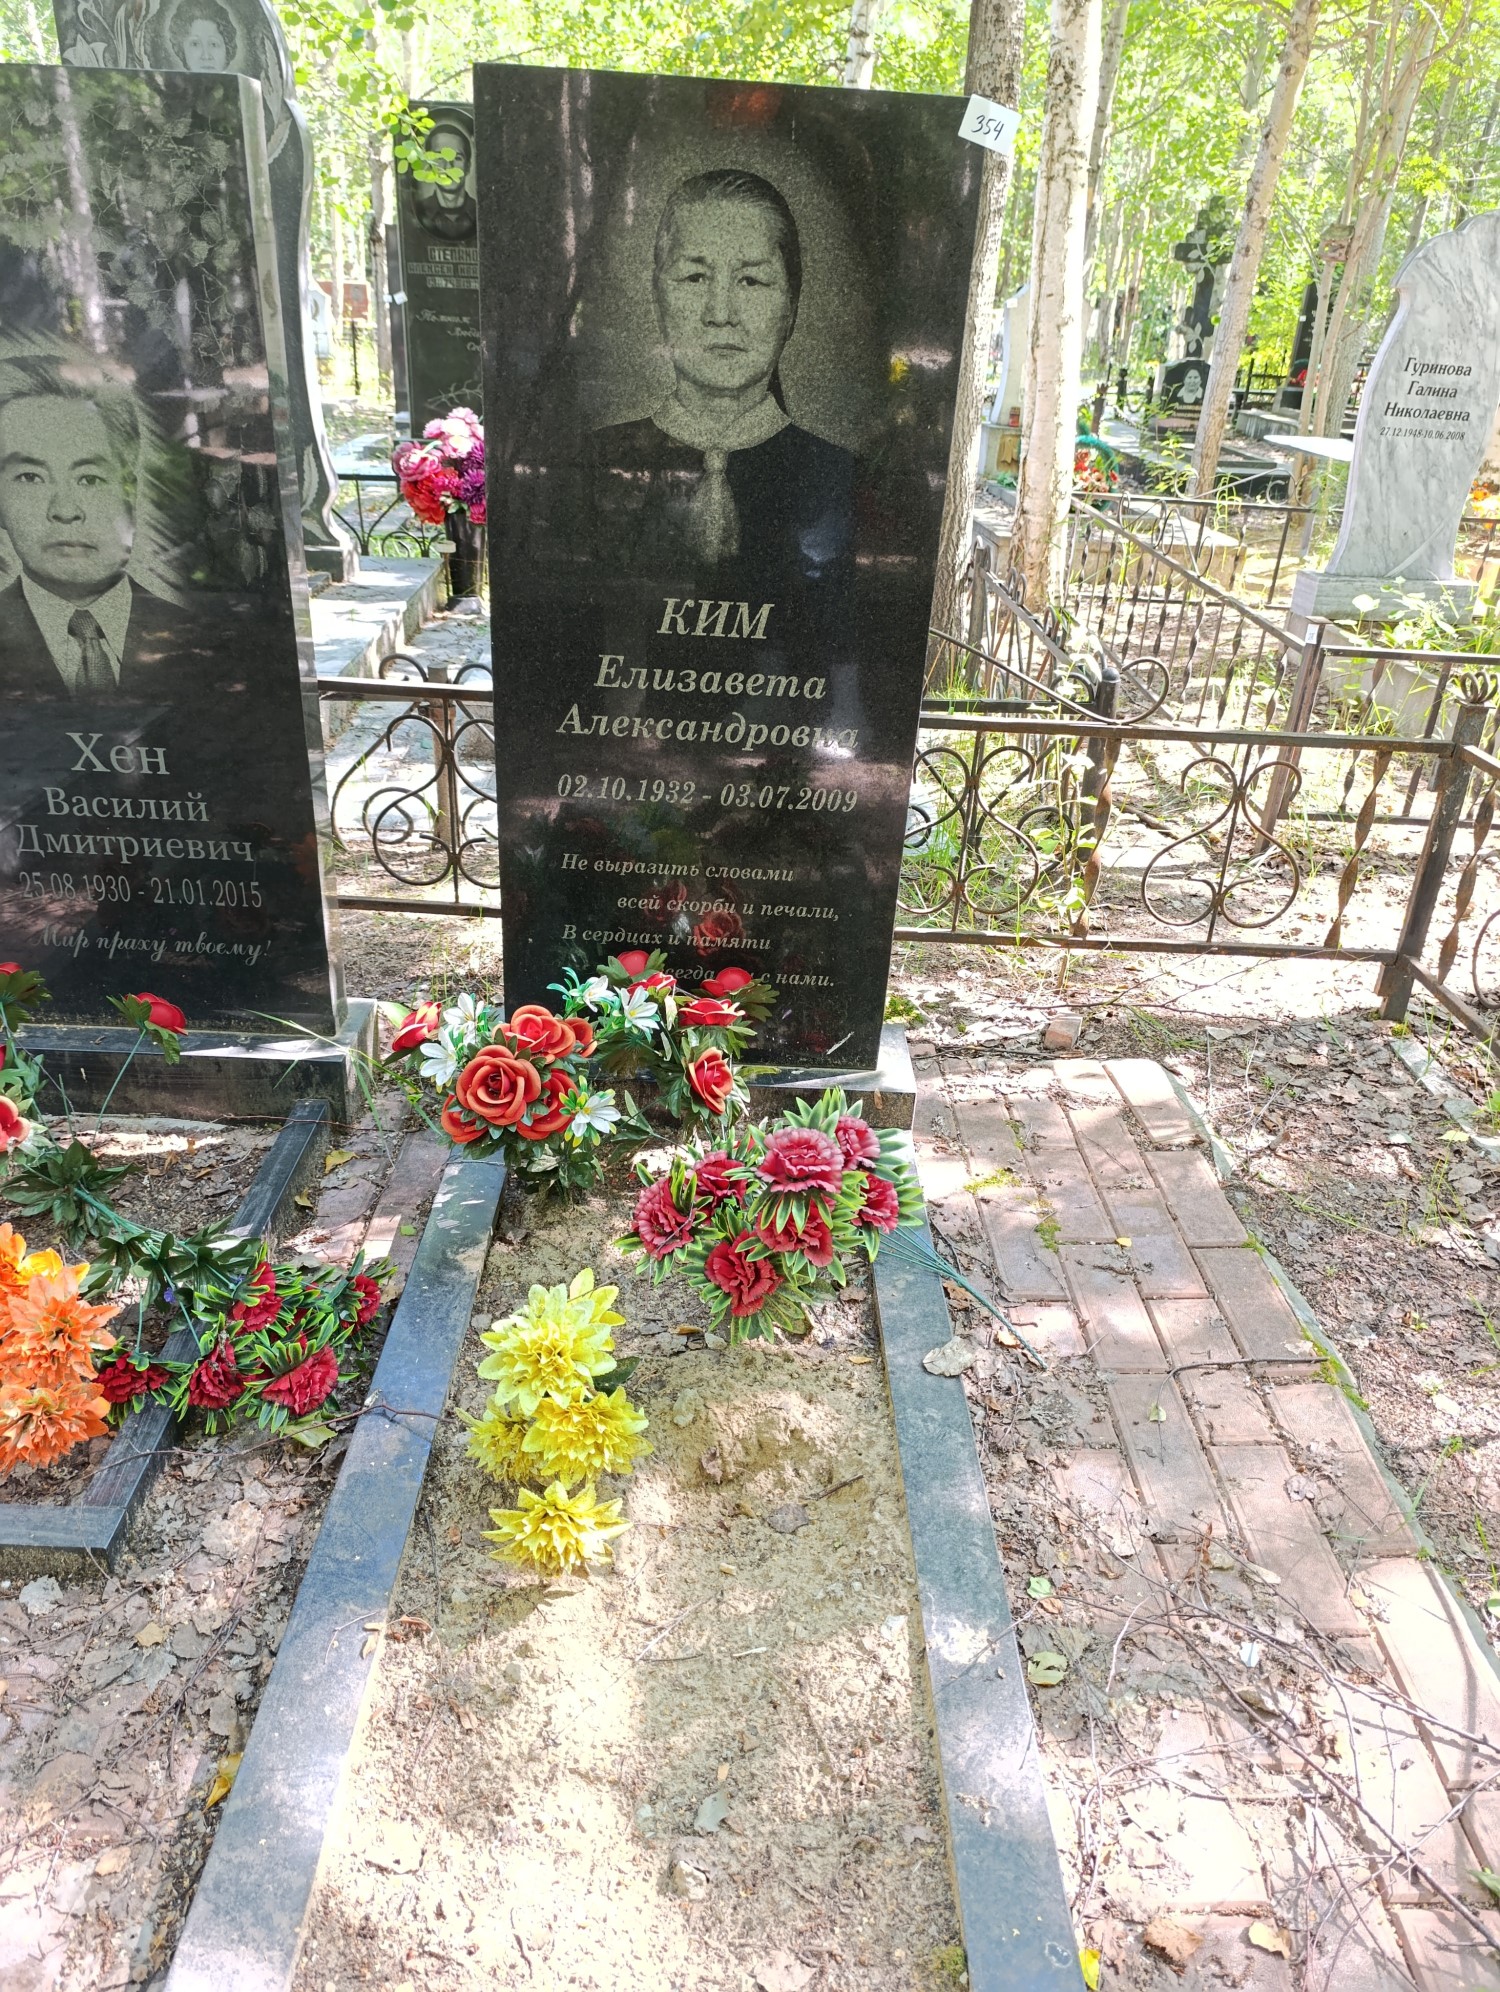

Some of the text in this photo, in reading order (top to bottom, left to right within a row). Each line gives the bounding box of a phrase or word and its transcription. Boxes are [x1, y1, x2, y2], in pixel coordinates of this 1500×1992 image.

[971, 114, 1005, 141] 354
[1404, 357, 1472, 376] Гуринова
[1407, 381, 1458, 398] Галина
[1384, 402, 1470, 421] Николаевна
[657, 598, 774, 639] КИМ
[594, 654, 826, 699] Елизавета
[556, 703, 858, 751] Александровна
[65, 732, 170, 774] Хен
[43, 787, 210, 822] Василий
[557, 773, 696, 804] 02.10.1932
[720, 783, 858, 813] 03.07.2009
[15, 824, 255, 864] Дмитриевич
[561, 853, 794, 882] Не выразить словами
[19, 871, 131, 902] 25.08.1930
[151, 878, 262, 908] 21.01.2015
[617, 892, 839, 922] всей скорби и печали,
[33, 923, 272, 966] Мир праху твоему!
[561, 924, 771, 951] В сердцах и памяти
[663, 964, 714, 981] сегда
[776, 972, 835, 987] нами.
